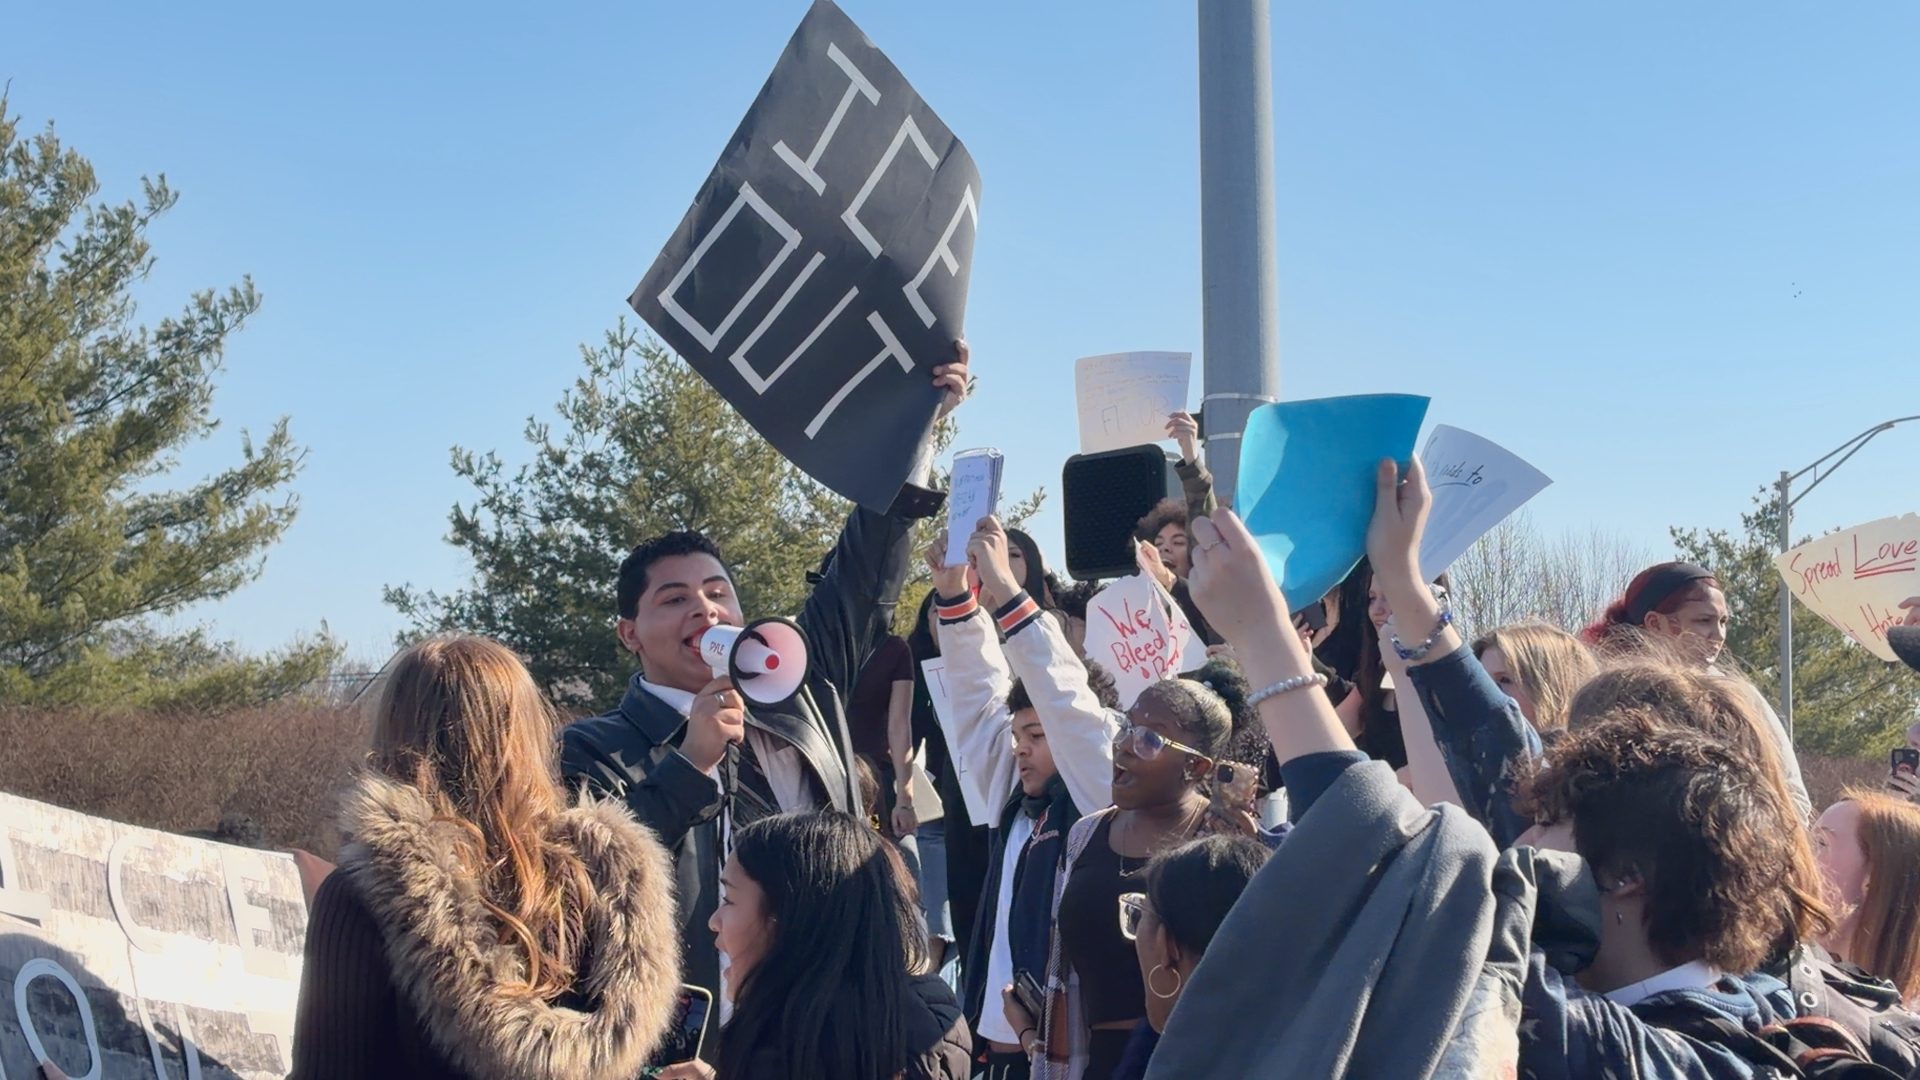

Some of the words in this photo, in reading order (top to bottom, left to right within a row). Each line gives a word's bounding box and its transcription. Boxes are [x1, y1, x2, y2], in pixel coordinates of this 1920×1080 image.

[772, 42, 977, 328] ICE
[657, 181, 915, 440] OUT
[1790, 547, 1842, 603] Spread
[1853, 534, 1917, 570] Love
[1098, 598, 1152, 639] We
[709, 640, 725, 656] PYLE
[1110, 629, 1166, 673] Bleed
